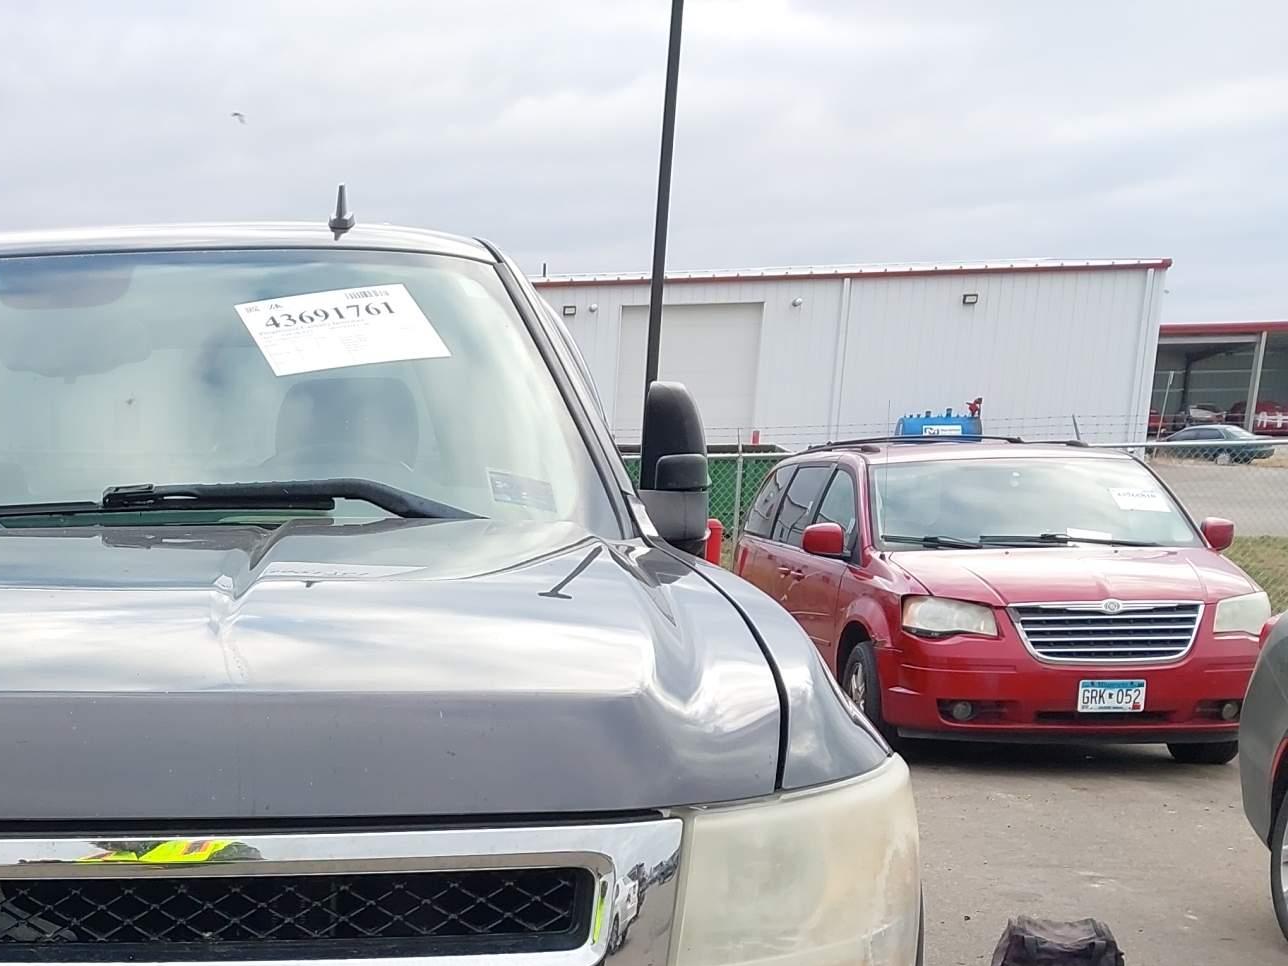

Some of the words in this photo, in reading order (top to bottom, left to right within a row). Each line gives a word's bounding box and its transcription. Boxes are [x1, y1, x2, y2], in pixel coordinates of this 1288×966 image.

[265, 301, 395, 328] 43691761
[1082, 688, 1106, 705] GRK
[1116, 688, 1141, 705] 052
